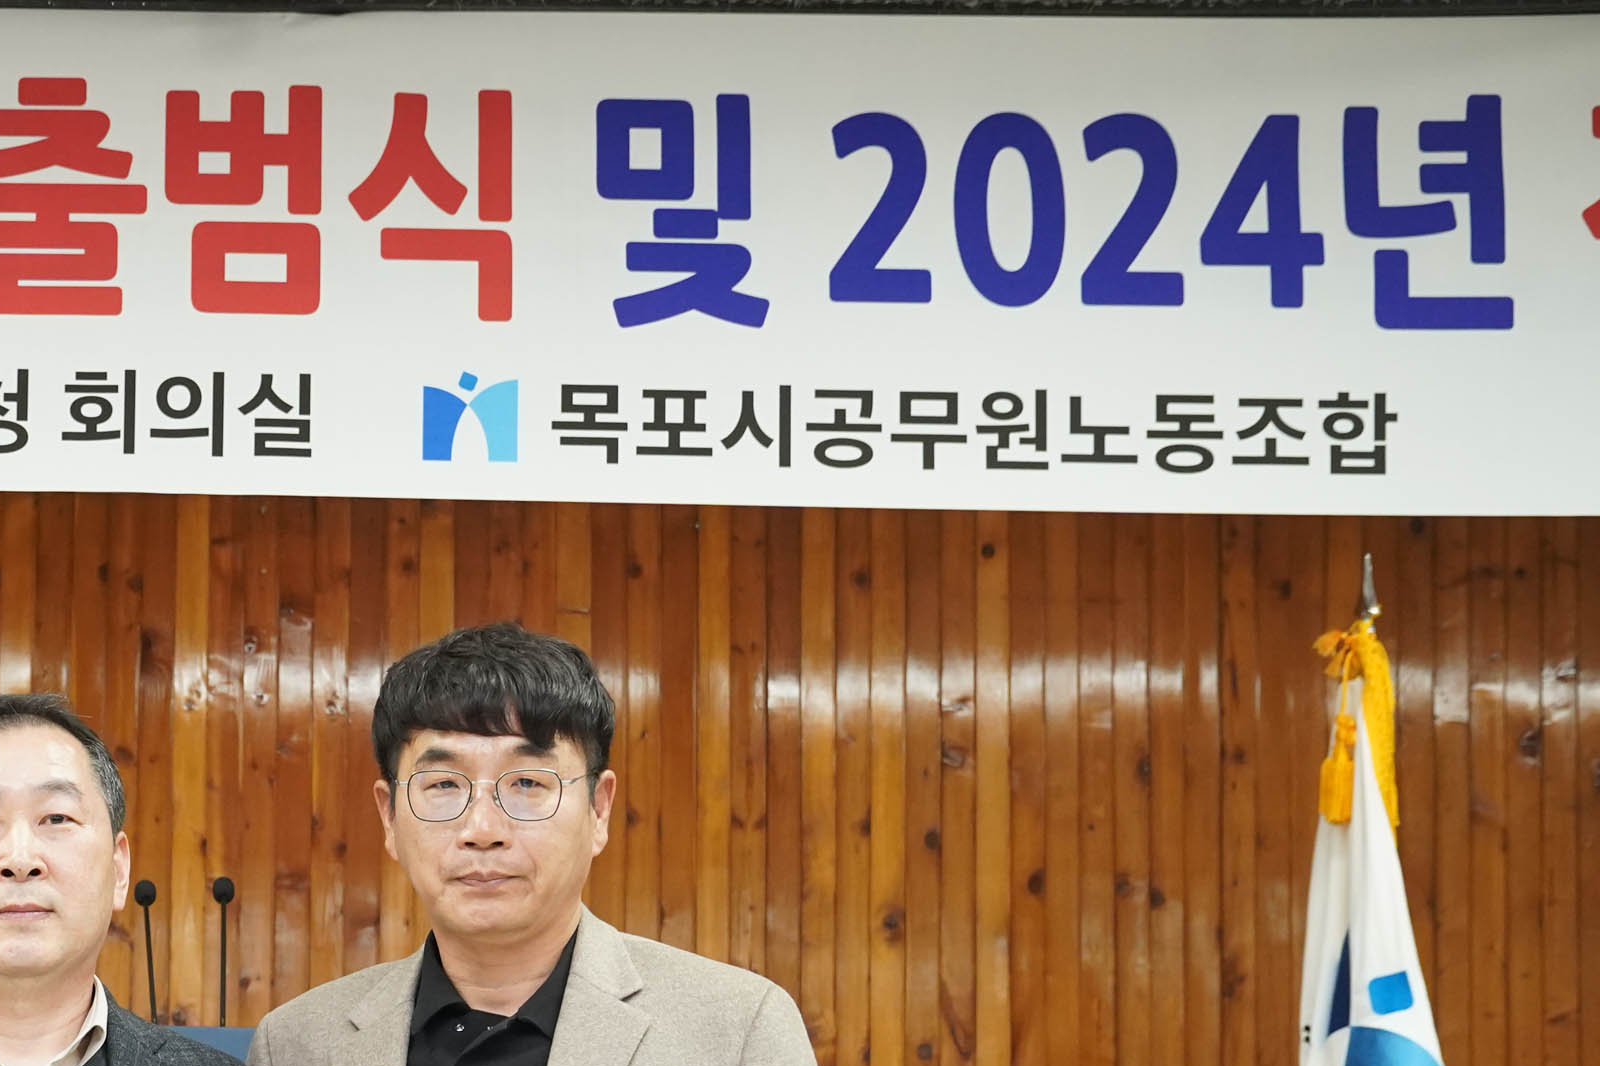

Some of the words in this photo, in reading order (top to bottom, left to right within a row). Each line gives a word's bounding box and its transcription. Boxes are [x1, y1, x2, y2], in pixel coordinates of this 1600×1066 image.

[595, 93, 771, 329] 및
[828, 94, 1515, 331] 2024년
[60, 368, 313, 459] 회의실
[550, 383, 1398, 476] 목포시공무원노동조합
